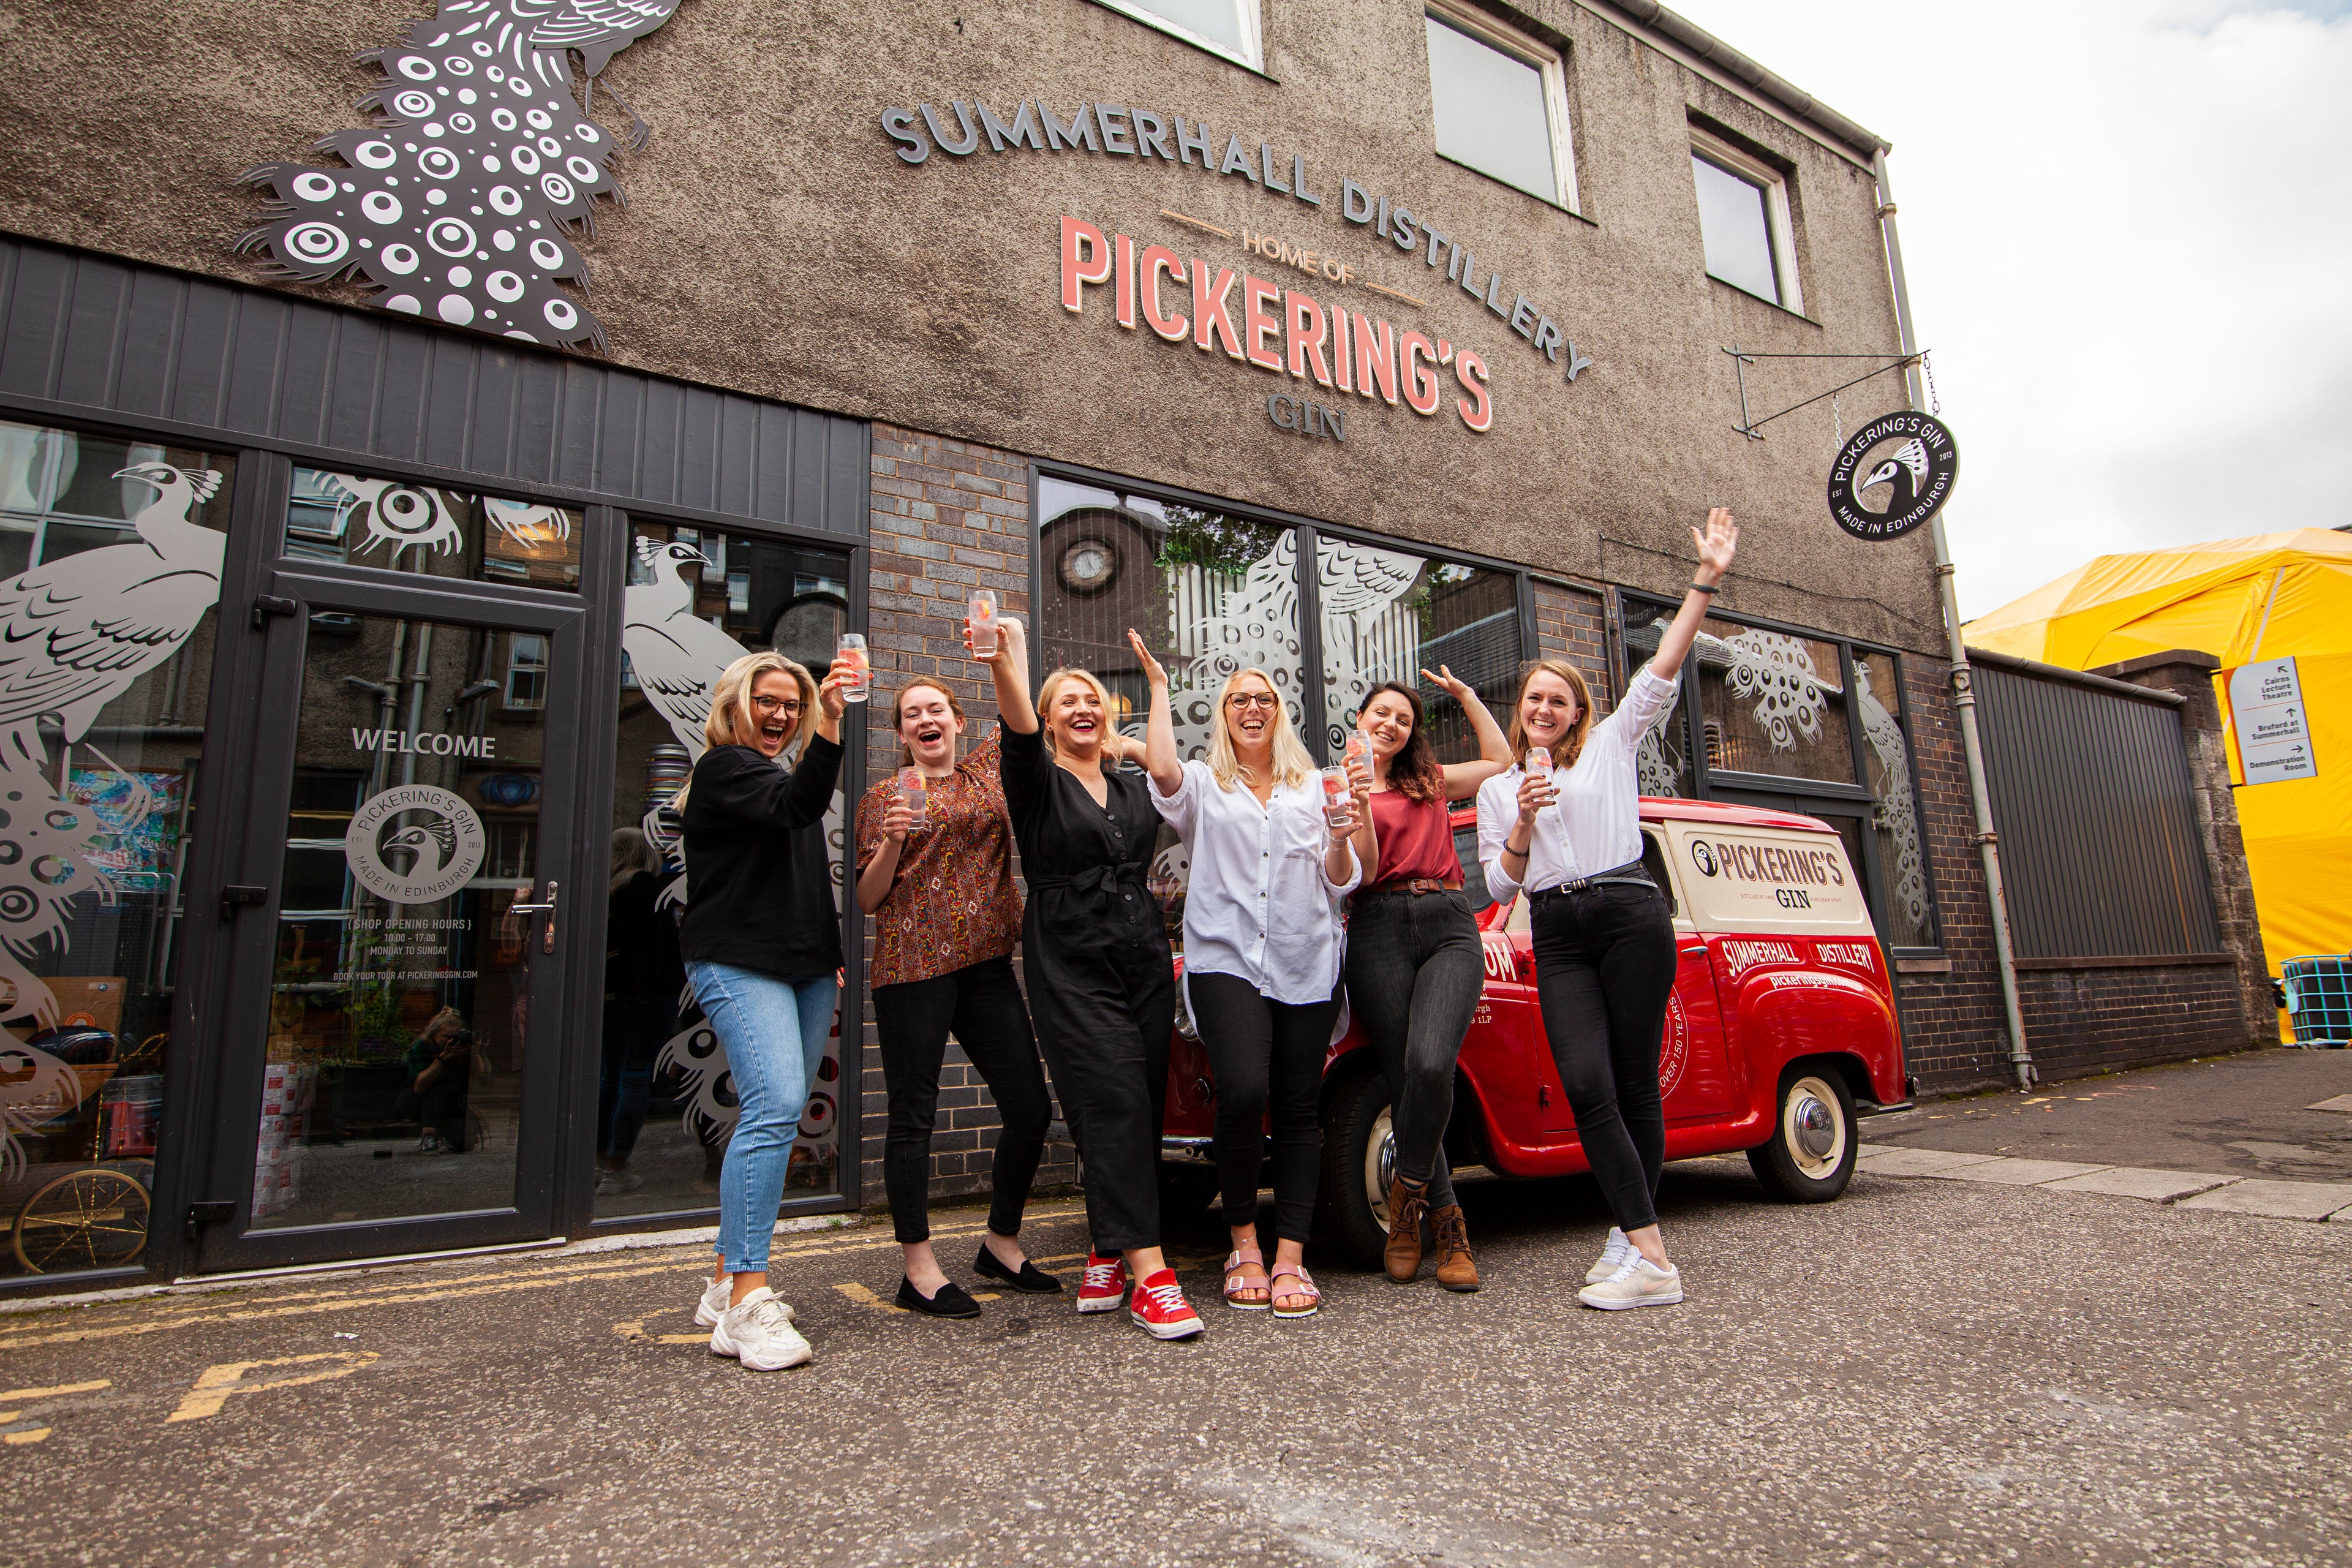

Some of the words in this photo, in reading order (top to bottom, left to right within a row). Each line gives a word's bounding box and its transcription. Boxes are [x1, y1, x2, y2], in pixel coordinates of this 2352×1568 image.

[881, 97, 1321, 206] SUMMERHALL
[1343, 176, 1593, 382] DISTILLERY
[1243, 228, 1319, 274] HOME
[1324, 258, 1356, 284] OF
[1060, 215, 1493, 431] PICKERING'S
[1267, 393, 1348, 442] GIN
[1835, 417, 1920, 481] PICKERING'S
[1920, 423, 1945, 449] GIN
[1939, 451, 1952, 461] 2013
[1832, 489, 1842, 498] EST
[1838, 505, 1866, 531] MADE
[1868, 523, 1881, 533] IN
[1887, 472, 1949, 532] EDINBURGH
[2261, 684, 2291, 693] Lecture
[2264, 676, 2290, 685] Cairns
[2262, 691, 2293, 701] Theatre
[2252, 727, 2301, 740] Summerhall
[2258, 722, 2288, 732] Bruford
[352, 728, 496, 758] WELCOME
[2250, 756, 2305, 769] Demonstration
[2285, 763, 2307, 772] Room
[357, 790, 456, 831] PICKERING'S
[454, 810, 477, 835] GIN
[1716, 843, 1845, 887] PICKERING'S
[355, 856, 383, 886] MADE
[384, 882, 399, 894] IN
[404, 858, 475, 896] EDINBURGH
[1776, 889, 1812, 909] GIN
[355, 919, 382, 930] SHOP
[385, 919, 429, 929] OPENING
[432, 919, 466, 929] HOURS
[384, 933, 405, 942] 10:00
[415, 933, 435, 942] 17:00
[370, 946, 403, 956] MONDAY
[405, 946, 415, 955] TO
[417, 946, 448, 955] SUNDAY
[1722, 940, 1800, 977] SUMMERHALL
[1815, 944, 1875, 973] DISTILLERY
[333, 972, 354, 981] BOOK
[356, 971, 375, 980] YOUR
[377, 971, 396, 980] TOUR
[407, 970, 478, 979] PICKERINGSGIN.COM
[1770, 974, 1853, 989] pickeringsgin.com
[1669, 997, 1683, 1036] YEARS
[1673, 1041, 1683, 1060] 150
[1659, 1061, 1678, 1088] OVER
